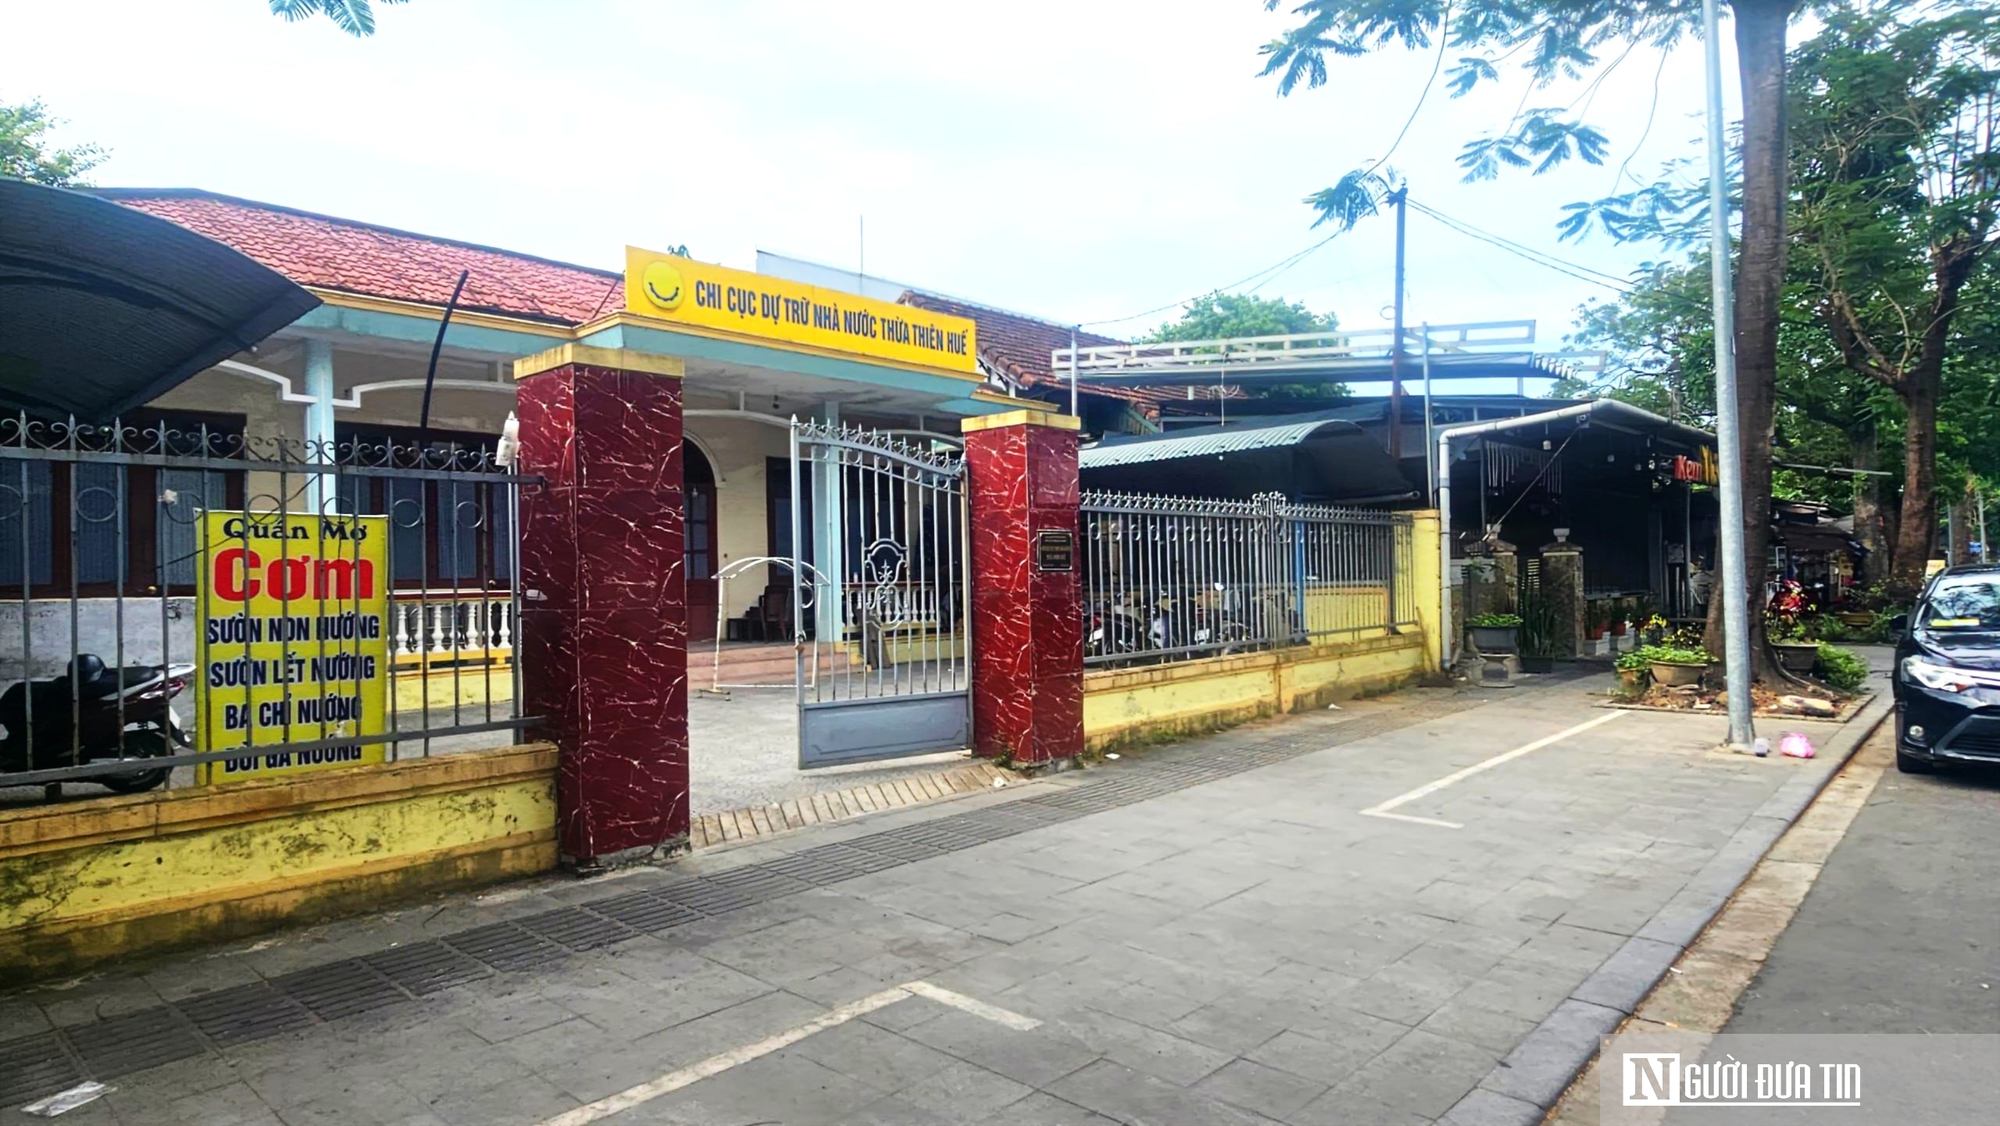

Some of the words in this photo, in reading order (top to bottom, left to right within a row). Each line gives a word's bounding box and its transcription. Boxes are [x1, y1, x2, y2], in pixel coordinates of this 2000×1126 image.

[695, 280, 722, 311] CHI
[727, 286, 757, 320] CỤC
[761, 292, 781, 325] DỰ
[813, 302, 841, 332] NHÀ
[843, 309, 877, 339] NƯỚC
[880, 316, 911, 345] THỪA
[912, 323, 944, 352] THIÊN
[947, 328, 969, 356] HUẾ
[222, 517, 310, 541] Quán
[322, 519, 368, 546] Mợ
[214, 547, 374, 602] Cơm
[207, 612, 263, 645] SƯỜN
[268, 615, 310, 642] NON
[210, 655, 267, 688] SƯỜN
[273, 651, 306, 685] LẾT
[311, 652, 376, 683] NƯỚNG
[224, 704, 253, 730] BA
[258, 694, 292, 727] CHỈ
